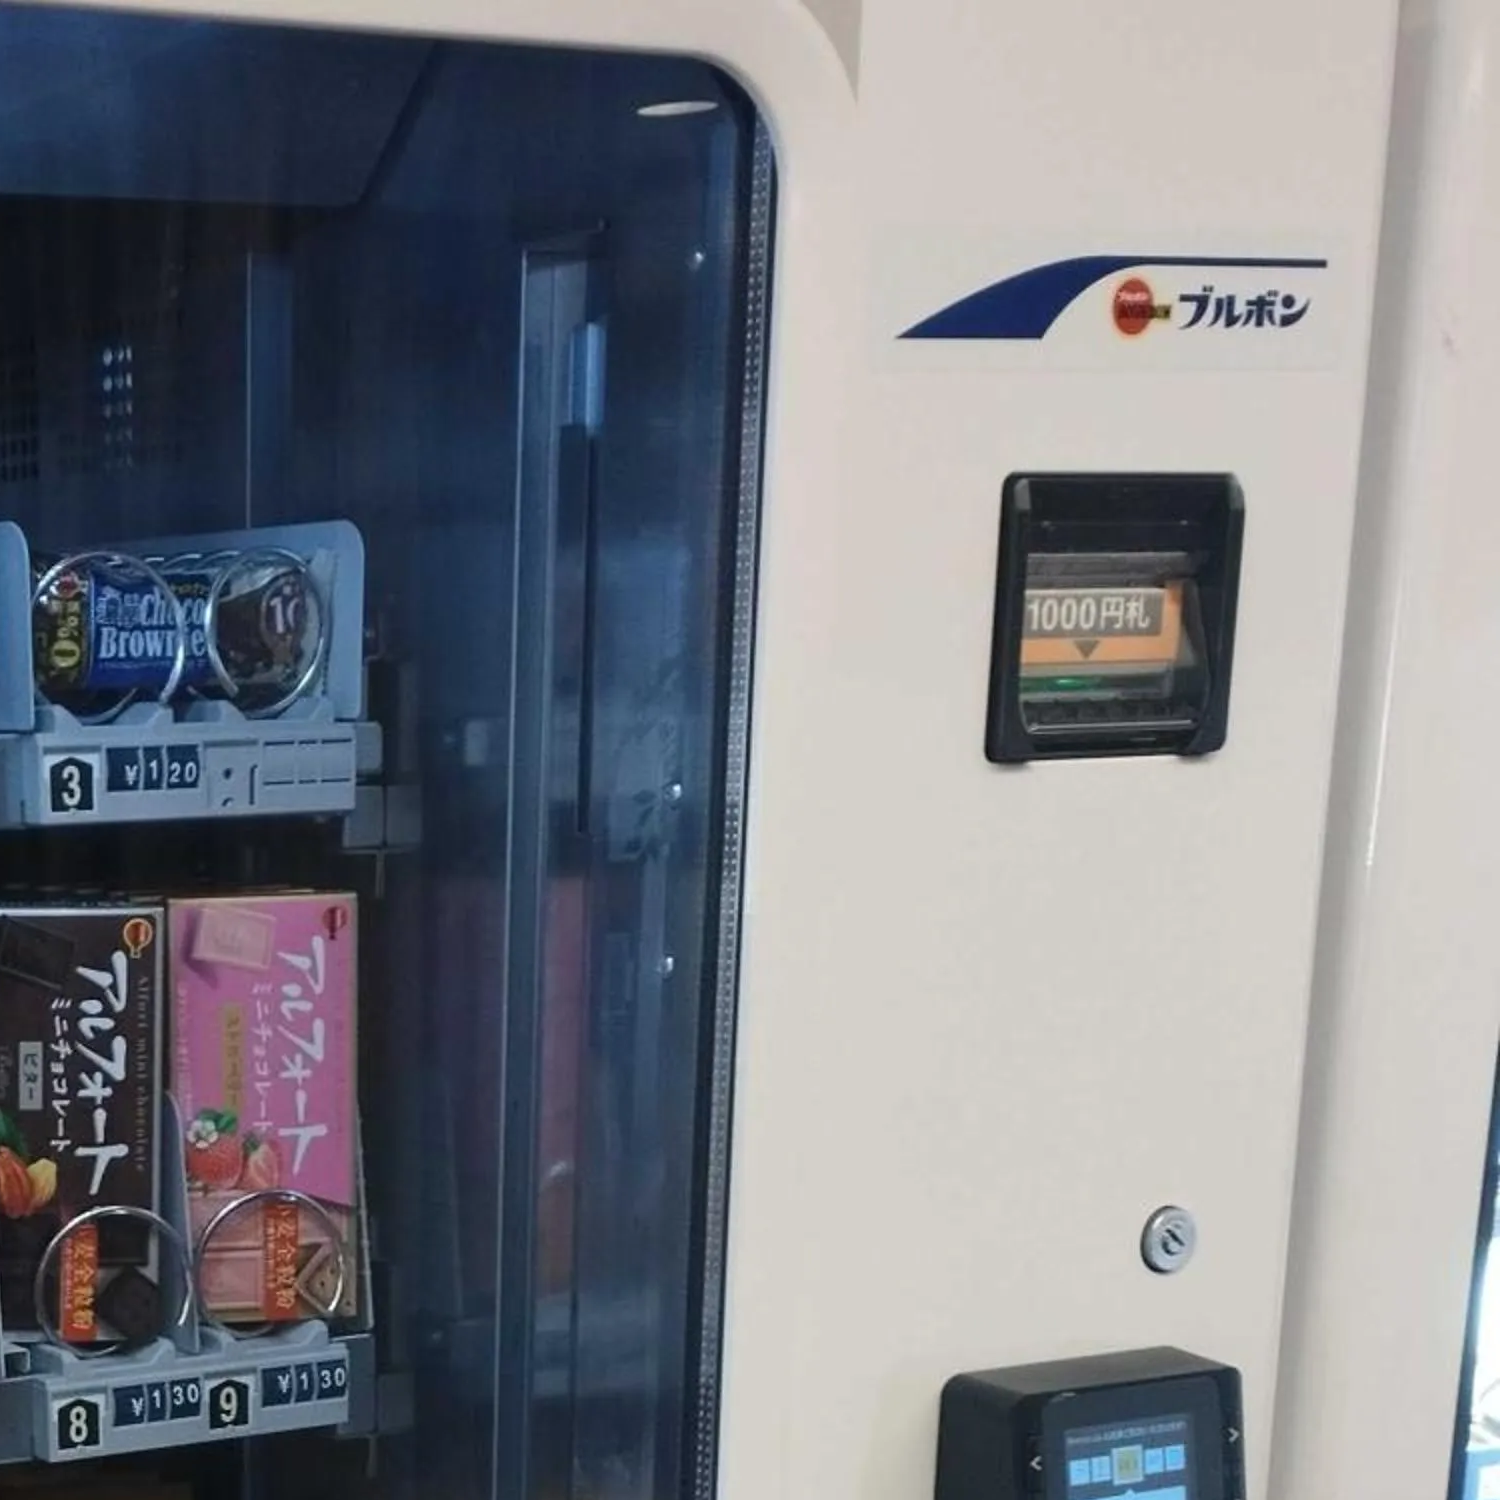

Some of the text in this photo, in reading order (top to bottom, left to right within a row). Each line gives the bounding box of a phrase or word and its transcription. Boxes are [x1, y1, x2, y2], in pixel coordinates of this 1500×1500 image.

[1178, 285, 1312, 330] ブルボン
[1027, 595, 1150, 631] 1000円札
[61, 761, 198, 806] 3 ¥120
[24, 1052, 41, 1100] ビター
[49, 996, 73, 1153] ミニチョコレート
[75, 949, 131, 1196] アルフォート
[251, 980, 274, 1134] ミニチョコレート
[276, 935, 329, 1176] アルフォート
[68, 1383, 200, 1446] 8 ¥130
[218, 1367, 346, 1424] 9 ¥130
